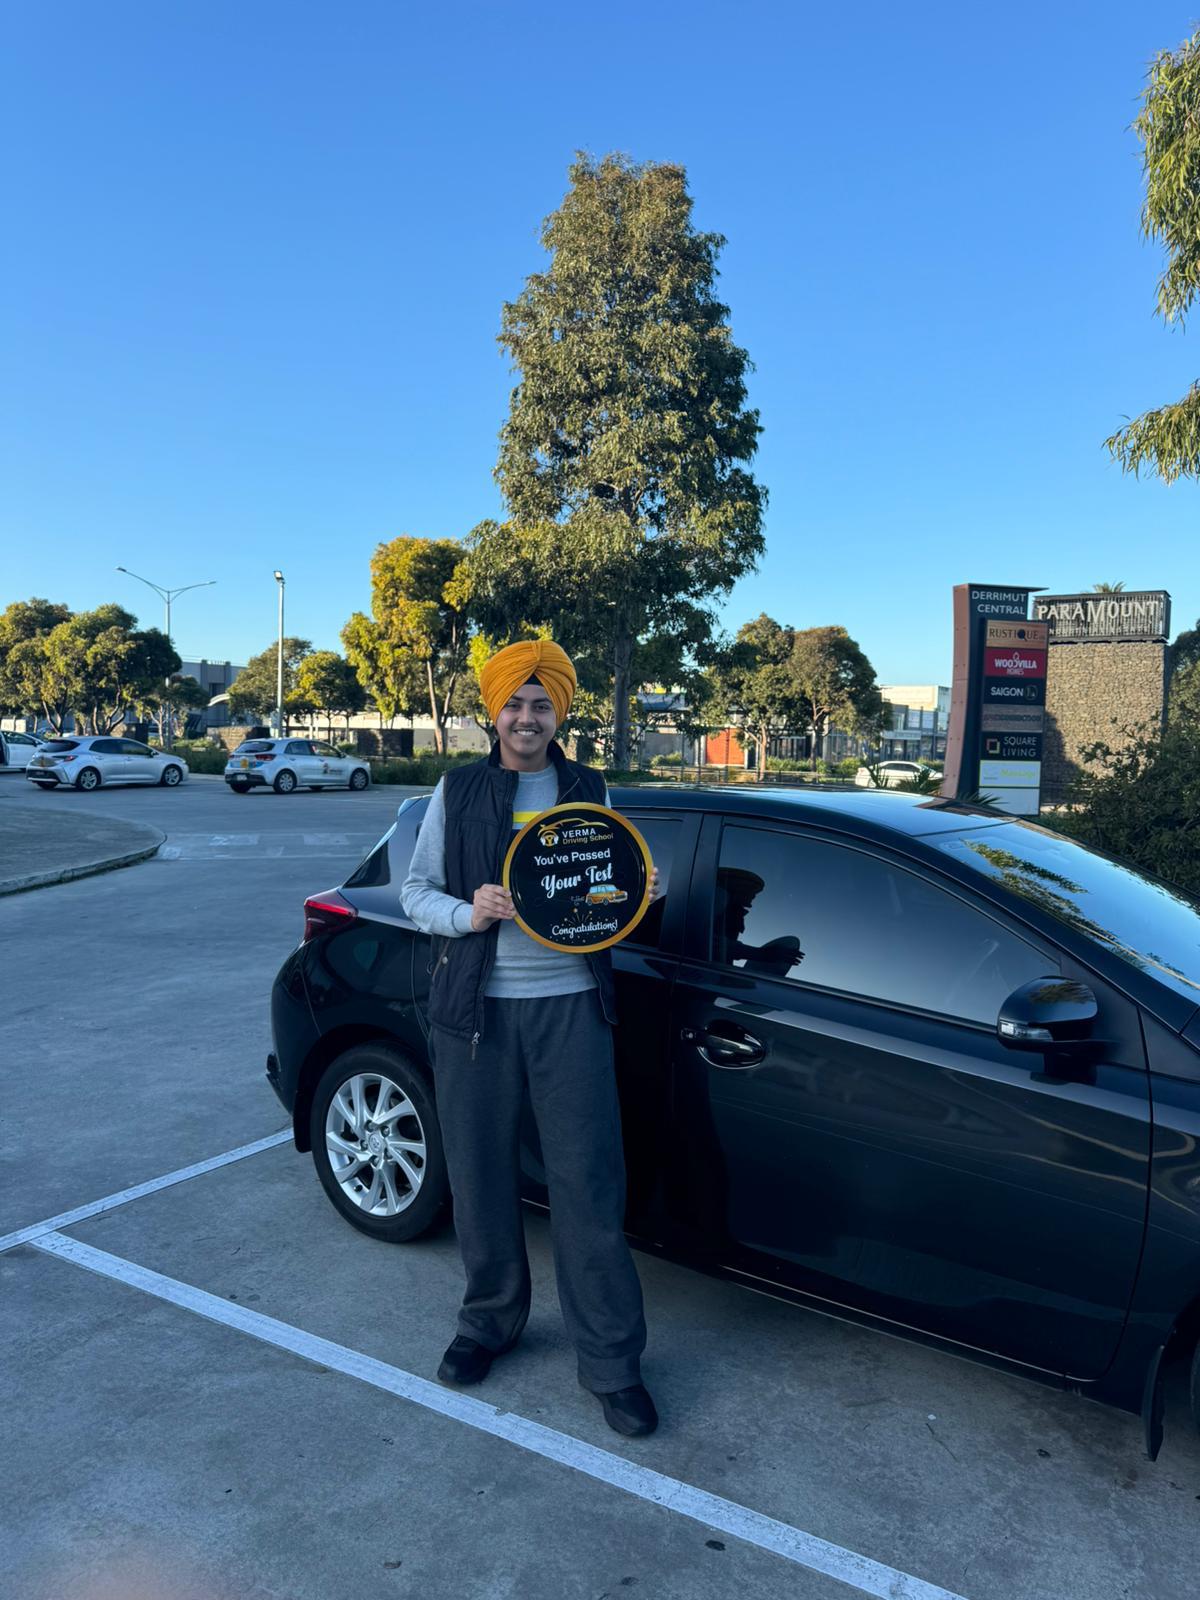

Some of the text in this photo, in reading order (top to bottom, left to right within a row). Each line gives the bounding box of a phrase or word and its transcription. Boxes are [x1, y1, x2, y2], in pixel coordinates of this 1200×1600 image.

[972, 590, 1026, 602] DERRIMUT
[977, 604, 1025, 615] CENTRAL
[1037, 600, 1158, 624] PARAMOUNT
[989, 628, 1039, 642] RUSTIQUE
[990, 686, 1024, 697] SAIGON
[1003, 736, 1037, 746] SQUARE
[1002, 748, 1036, 757] LIVING
[561, 828, 596, 838] VERMA
[562, 833, 614, 845] Driving School
[534, 848, 611, 866] You've Passed
[540, 862, 614, 899] Your Test
[551, 919, 618, 939] Congratulations!
